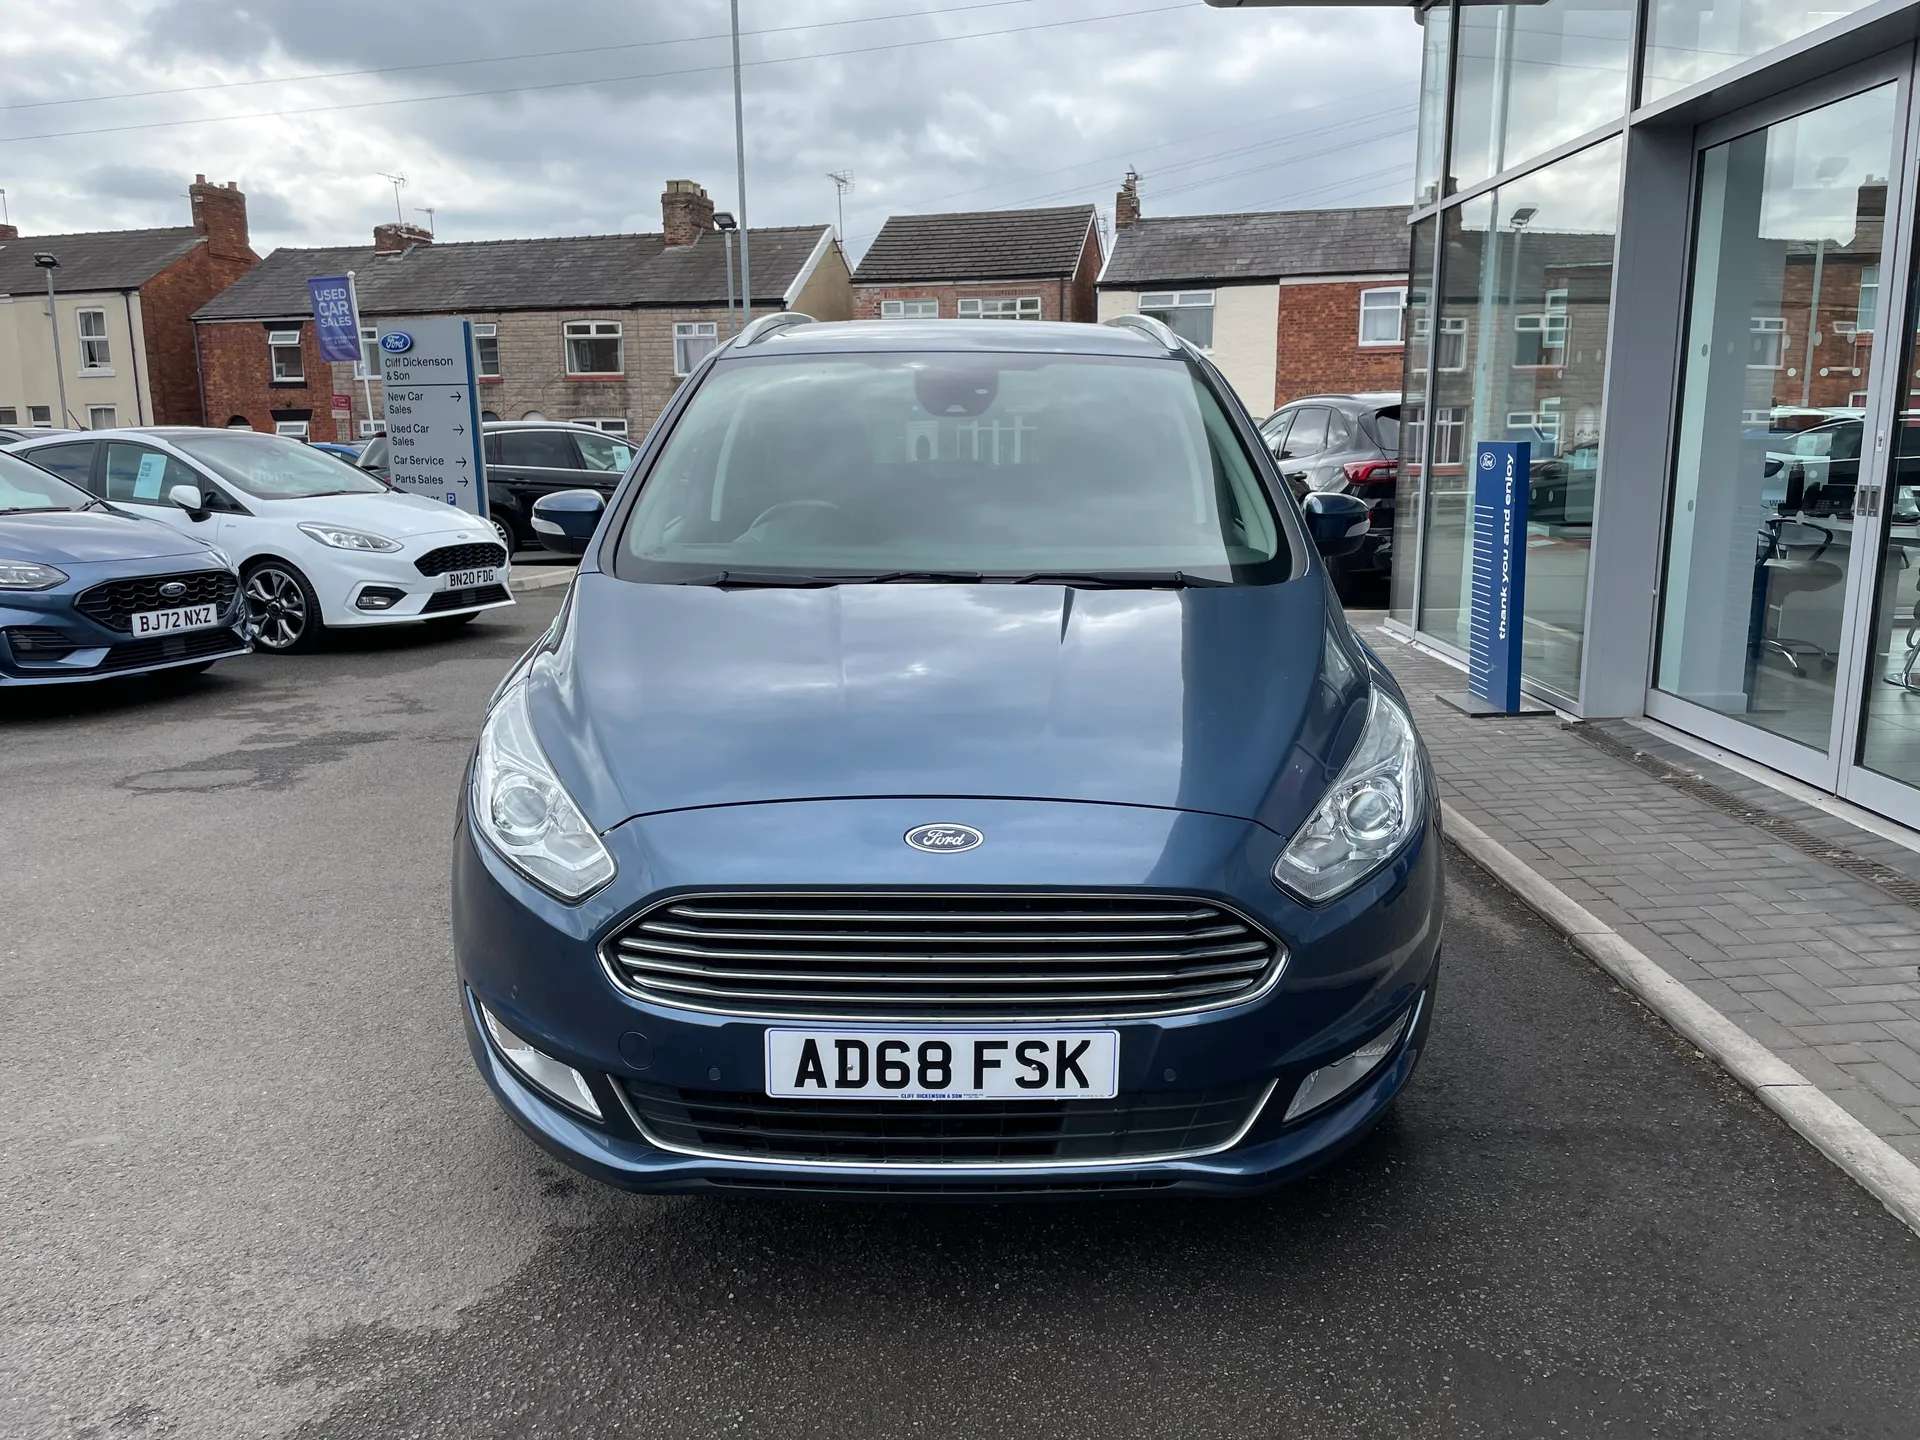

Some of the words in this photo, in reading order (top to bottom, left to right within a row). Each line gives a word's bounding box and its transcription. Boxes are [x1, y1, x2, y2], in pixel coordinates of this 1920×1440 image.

[314, 288, 347, 301] USED
[318, 301, 349, 316] CAR
[320, 316, 352, 328] SALES
[385, 335, 405, 349] Ford
[385, 357, 401, 368] Cliff
[402, 357, 454, 367] Dickenson
[386, 371, 392, 381] &
[393, 370, 410, 381] Son
[388, 392, 406, 401] New
[407, 391, 424, 401] Car
[389, 404, 412, 414] Sales
[390, 423, 412, 433] Used
[413, 423, 430, 433] Car
[392, 436, 415, 446] Sales
[393, 455, 408, 465] Car
[409, 455, 445, 466] Service
[395, 474, 417, 484] Parts
[417, 474, 444, 485] Sales
[1505, 453, 1514, 506] enjoy
[1503, 508, 1511, 546] and
[1501, 549, 1509, 583] you
[449, 571, 475, 587] BN20
[476, 569, 494, 583] FDG
[1499, 586, 1508, 640] thank
[139, 611, 180, 633] BJ72
[184, 607, 212, 626] NXZ
[922, 829, 966, 846] Ford
[794, 1038, 953, 1090] AD68
[973, 1039, 1091, 1090] FSK
